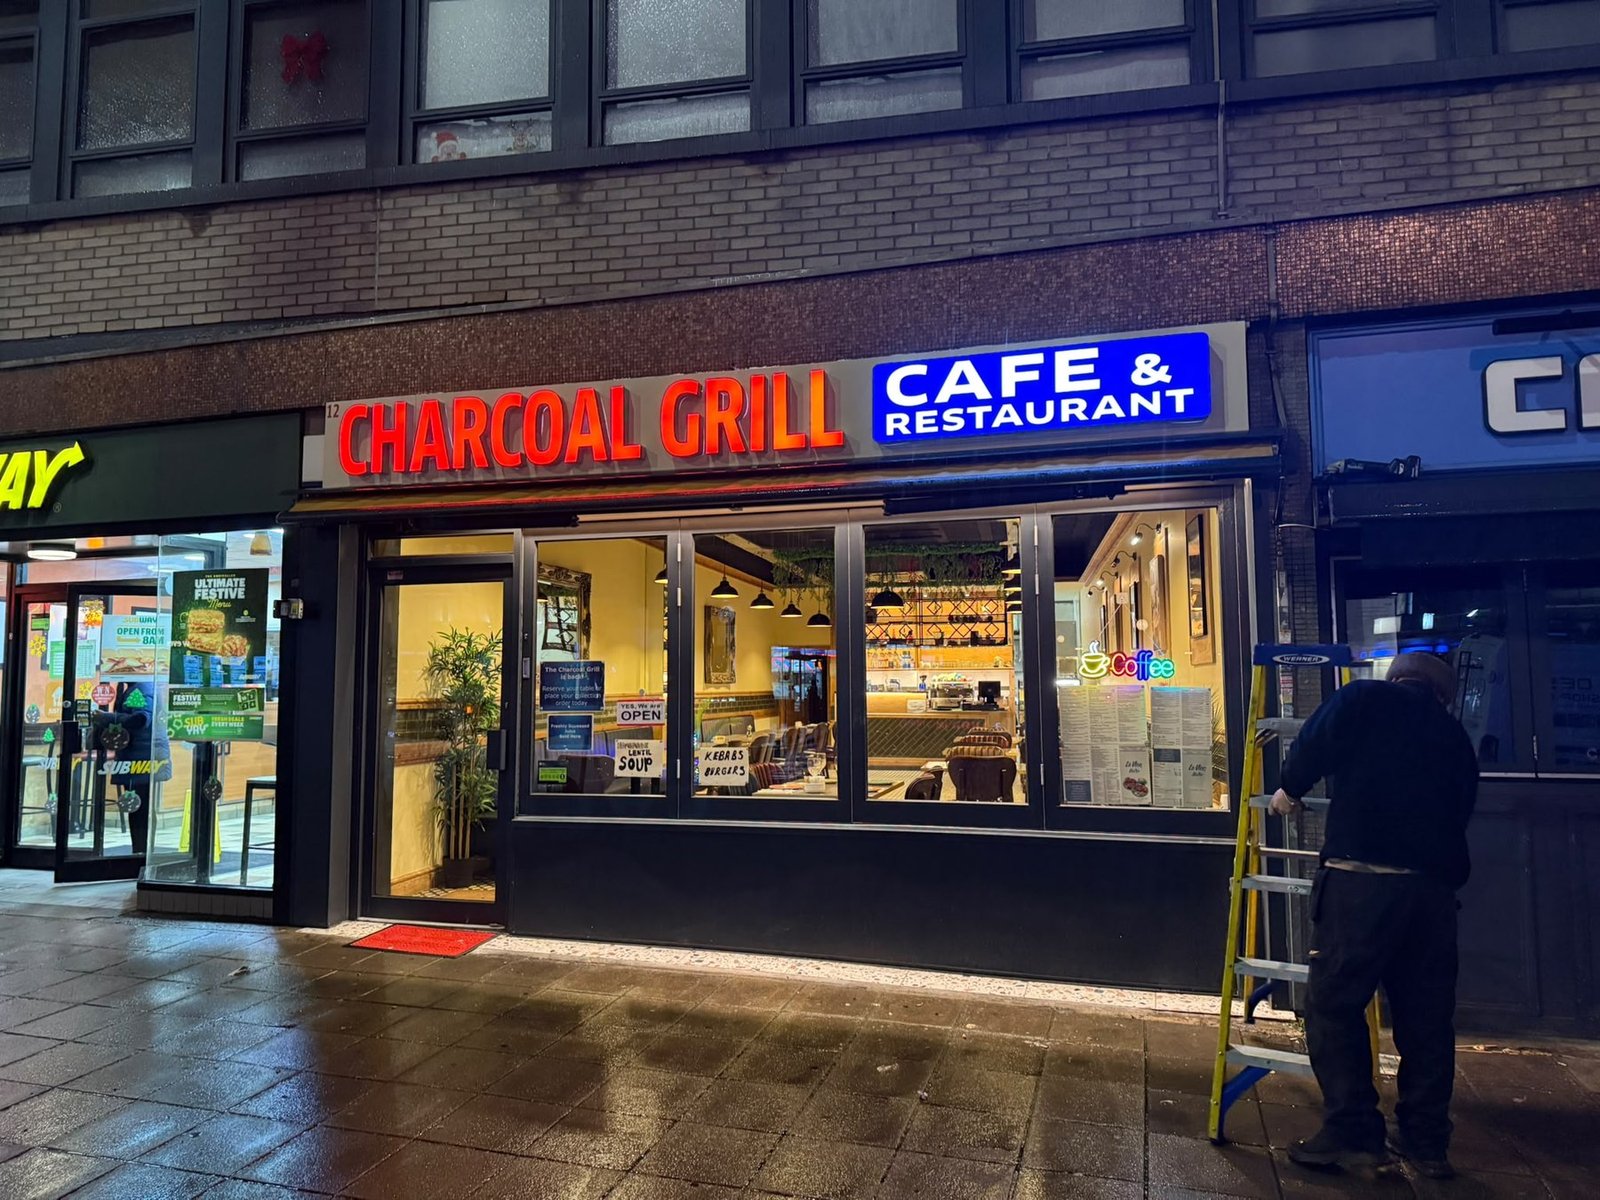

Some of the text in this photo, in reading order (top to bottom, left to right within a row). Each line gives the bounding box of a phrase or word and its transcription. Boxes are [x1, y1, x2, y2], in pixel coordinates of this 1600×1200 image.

[886, 347, 1172, 406] CAFE &
[327, 404, 339, 418] 12
[886, 388, 1194, 436] RESTAURANT
[338, 369, 845, 476] CHARCOAL GRILL
[194, 578, 246, 588] ULTIMATE
[194, 588, 246, 600] FESTIVE
[208, 599, 232, 609] Menu
[117, 627, 164, 635] OPEN FROM
[142, 636, 164, 645] 8AM
[1111, 650, 1174, 681] Coffee
[173, 694, 202, 702] FESTIVE
[184, 716, 204, 726] SUB
[621, 710, 661, 721] OPEN
[628, 749, 652, 757] LENTIL
[704, 750, 744, 761] KEBABS
[97, 758, 169, 775] SUBWAY
[618, 756, 653, 772] SOUP
[704, 765, 746, 777] BURGERS
